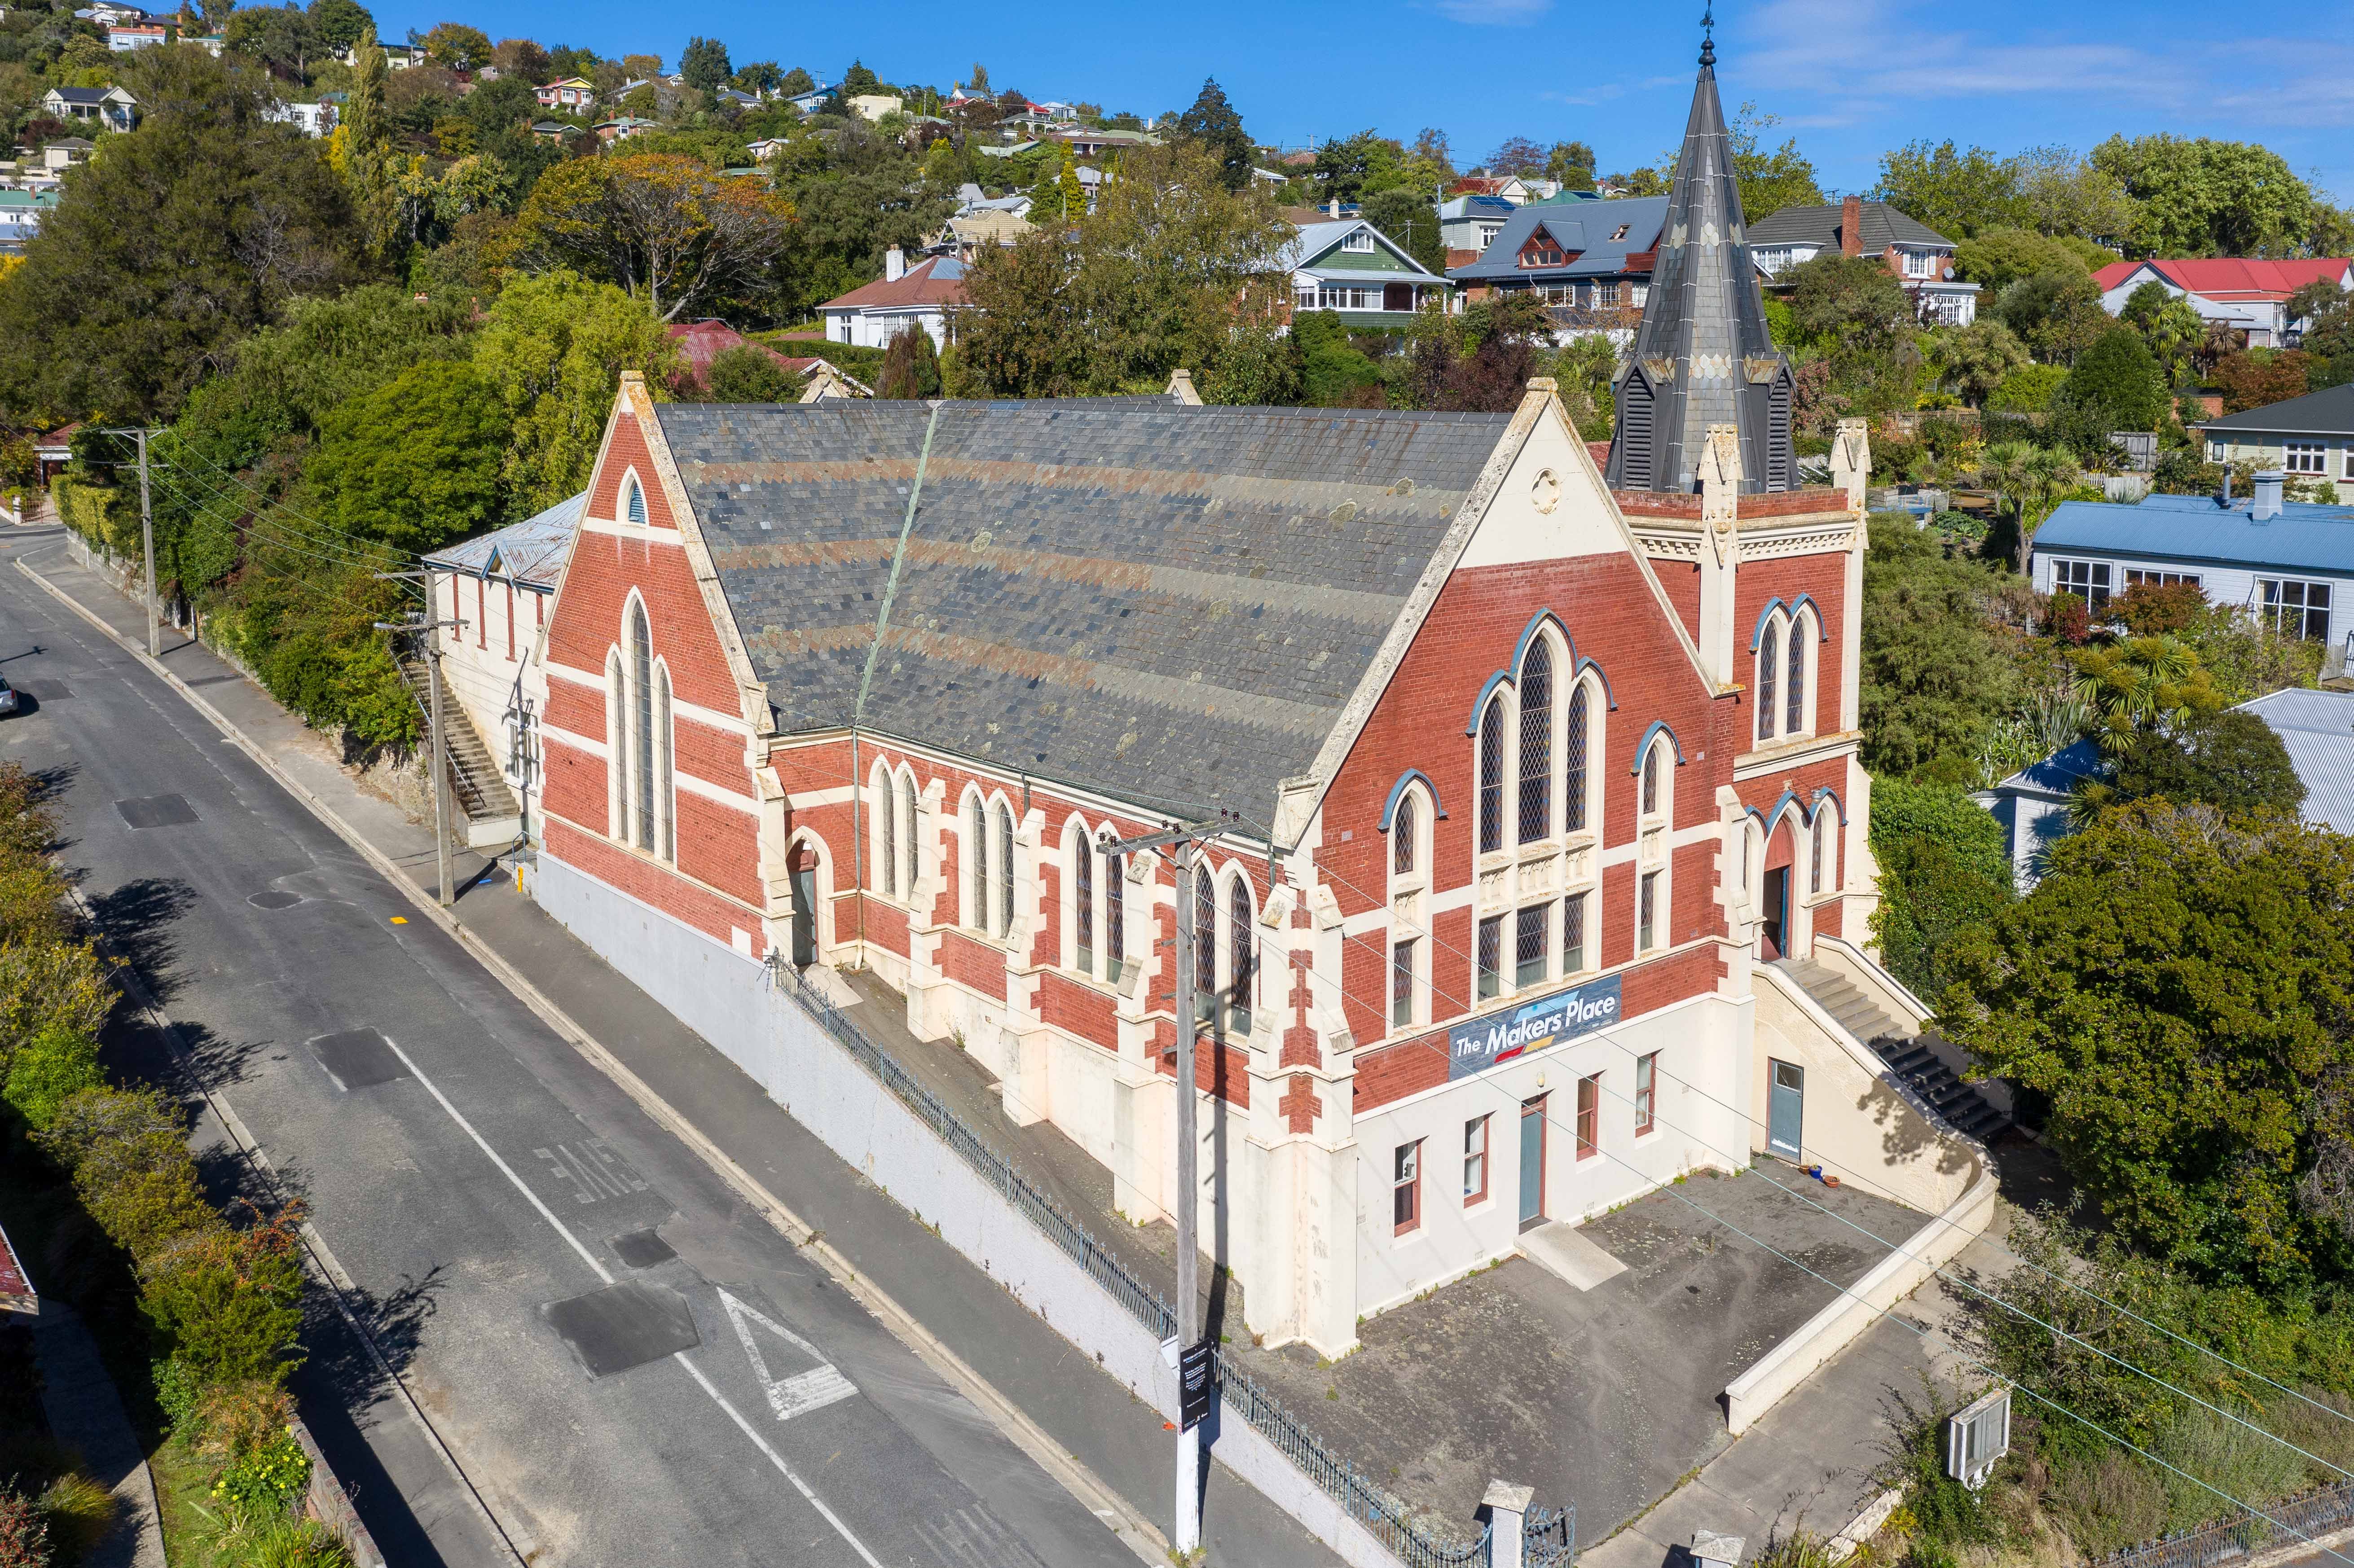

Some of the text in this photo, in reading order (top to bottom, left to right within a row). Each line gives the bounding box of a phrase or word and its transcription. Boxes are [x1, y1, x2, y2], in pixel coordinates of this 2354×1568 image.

[1456, 996, 1615, 1057] The Makers Place
[532, 1138, 649, 1204] GIVE
